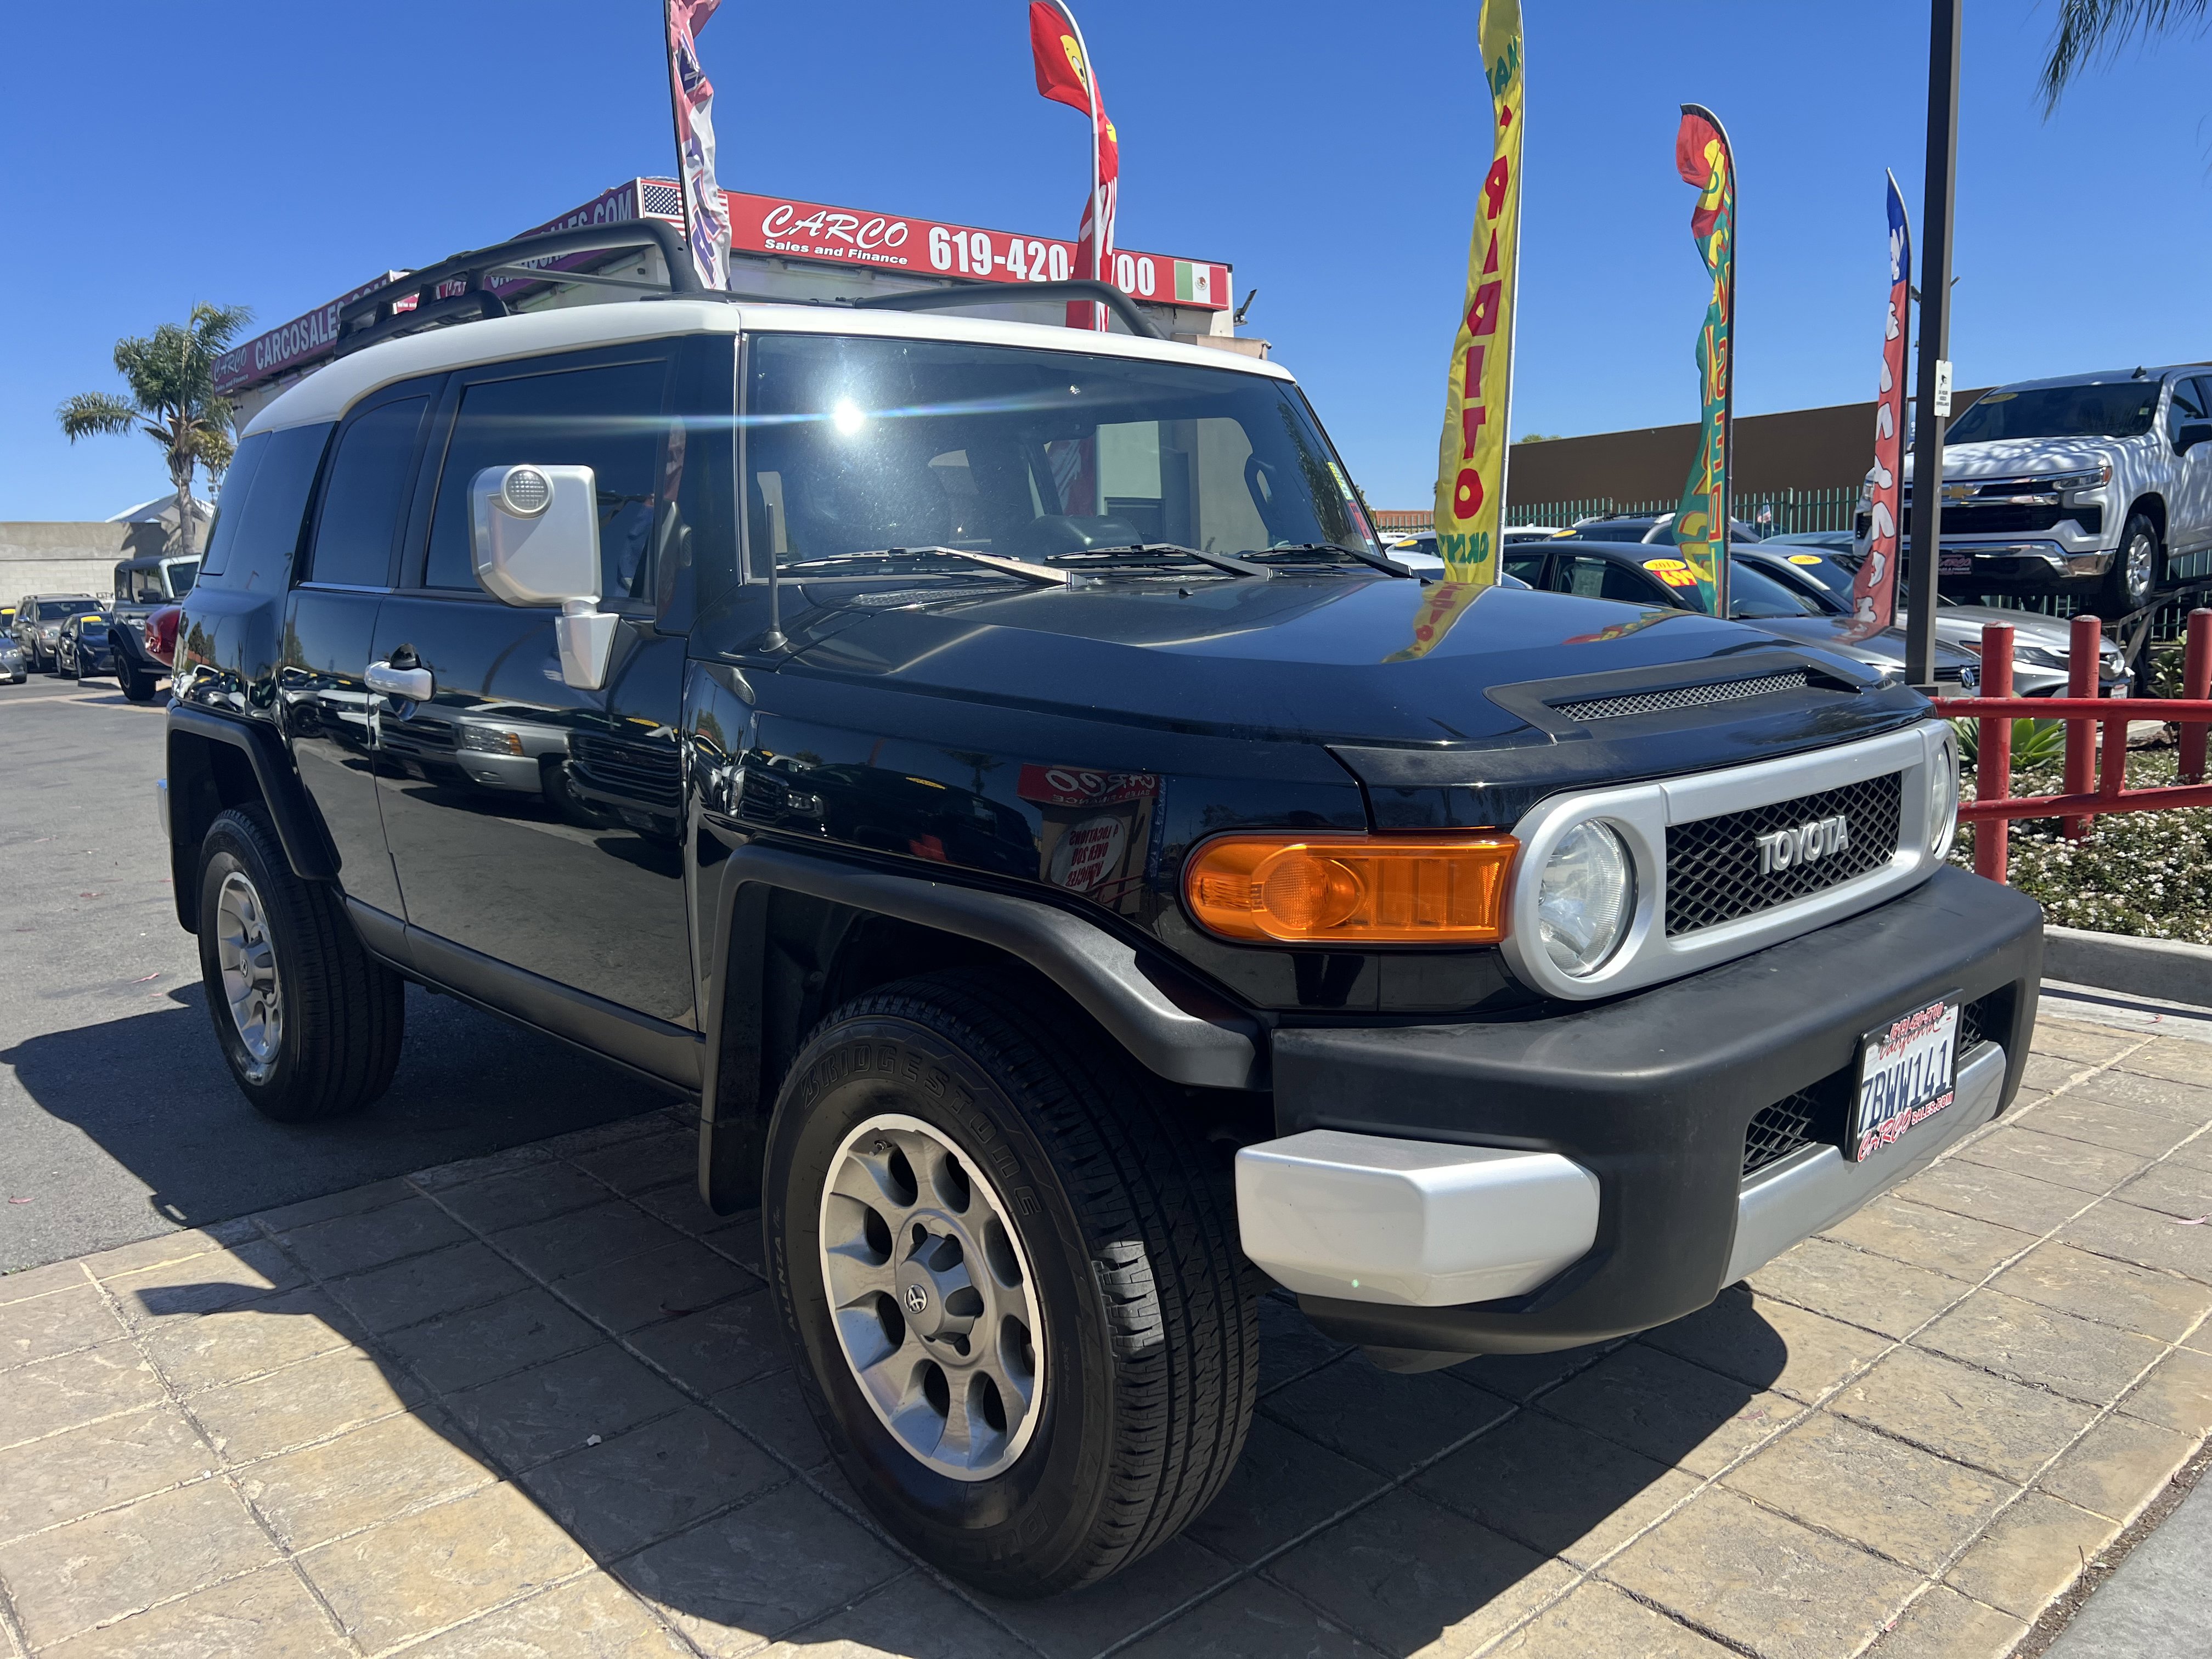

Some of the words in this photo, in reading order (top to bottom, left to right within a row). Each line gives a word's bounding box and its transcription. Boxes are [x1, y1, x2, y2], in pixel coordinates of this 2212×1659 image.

[761, 205, 909, 249] CARCO
[765, 239, 809, 253] Sales
[814, 246, 843, 257] and
[848, 249, 908, 265] Finance
[928, 226, 1155, 296] 619-420-00
[213, 347, 247, 382] CARCO
[1652, 561, 1677, 569] 2011
[1756, 815, 1849, 875] TOYOTA
[1858, 1039, 1948, 1133] 7BWW141
[800, 1043, 1042, 1216] BRIDGESTONE
[1858, 1106, 1912, 1163] CARCO
[1911, 1090, 1954, 1125] SALES.COM
[774, 1236, 797, 1332] ALENZA
